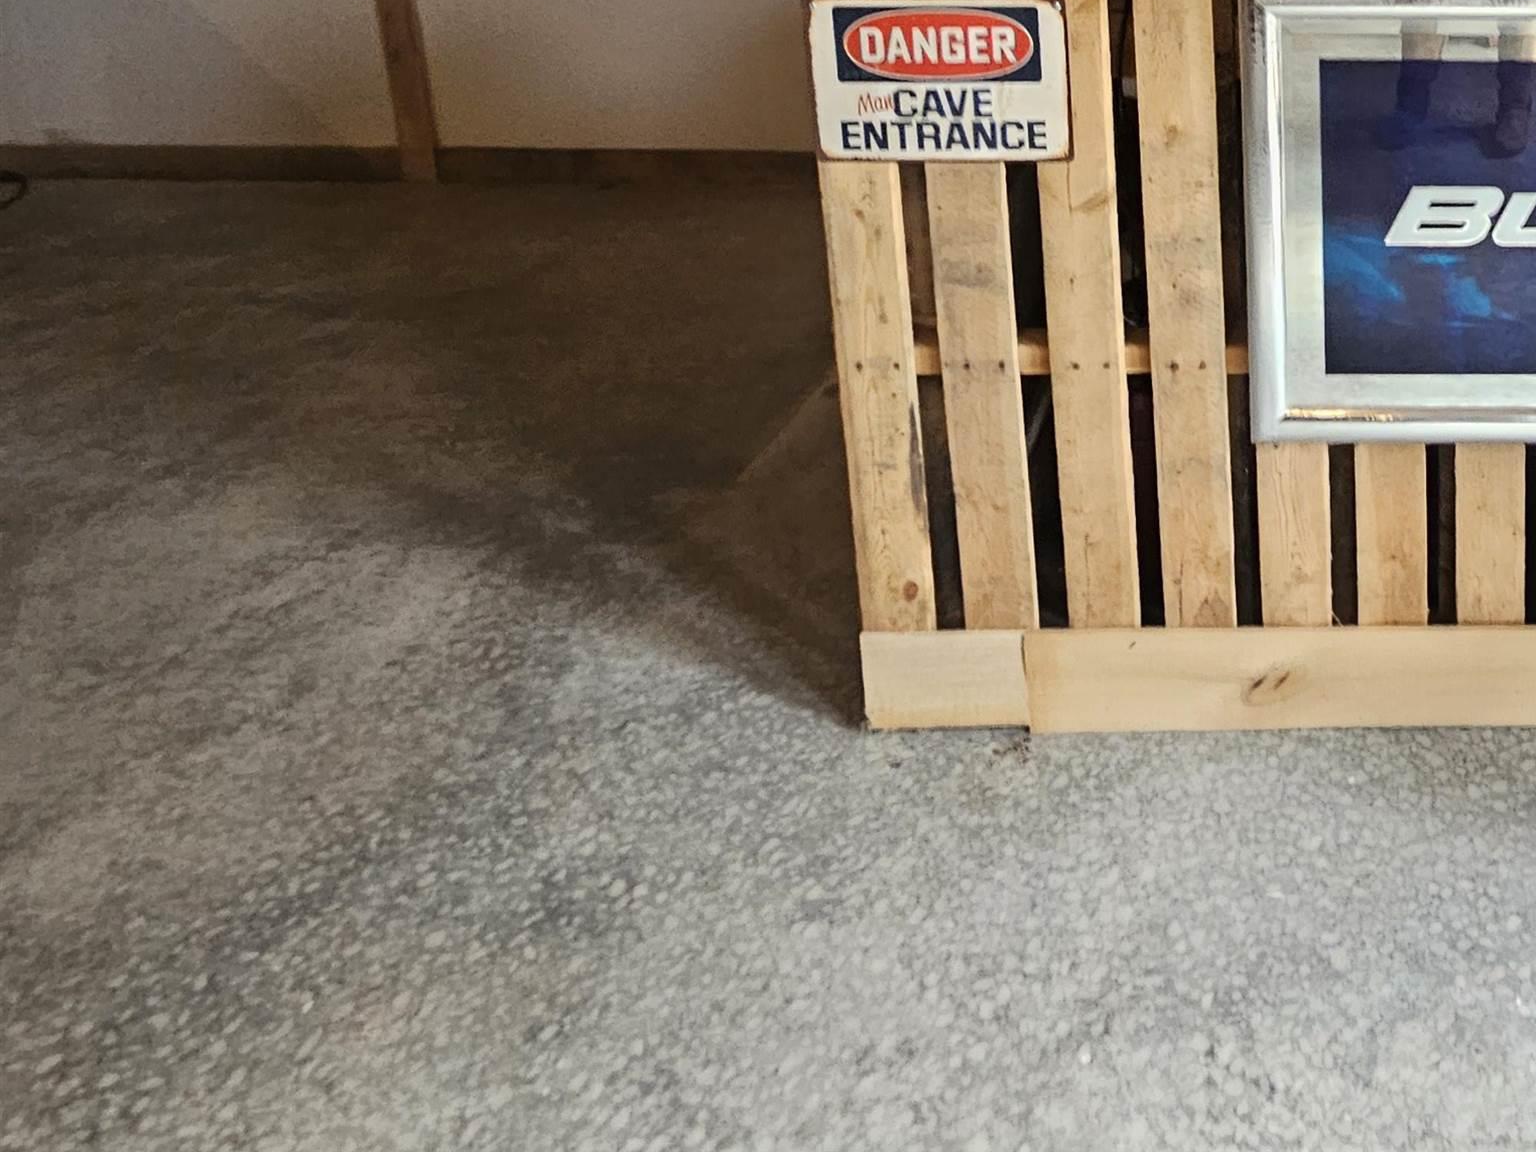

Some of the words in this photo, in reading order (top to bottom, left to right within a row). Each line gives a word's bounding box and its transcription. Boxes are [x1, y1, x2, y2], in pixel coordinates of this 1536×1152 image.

[859, 25, 1018, 65] DANGER
[857, 91, 894, 117] Man
[893, 88, 993, 117] CAVE
[840, 119, 1048, 150] ENTRANCE
